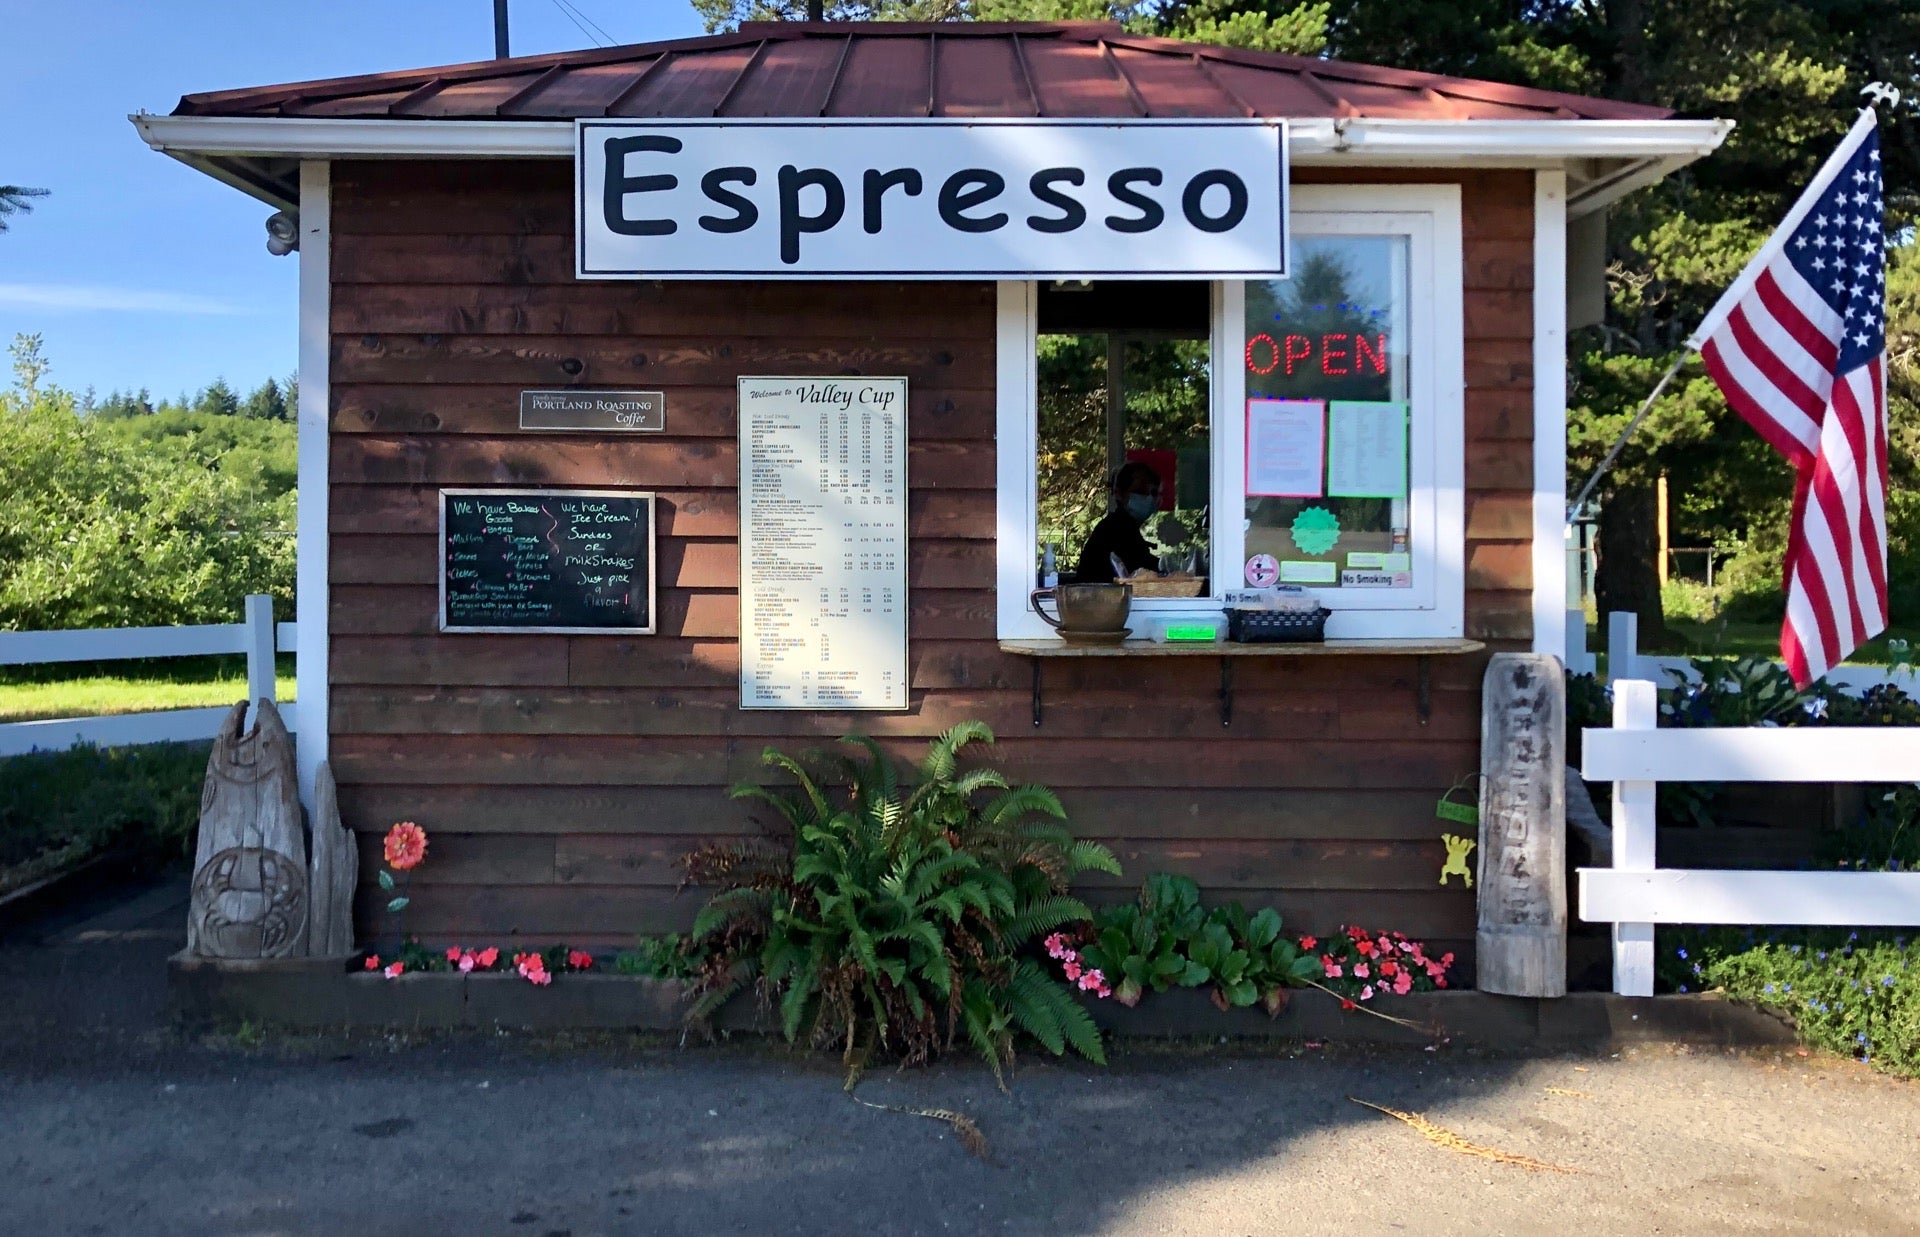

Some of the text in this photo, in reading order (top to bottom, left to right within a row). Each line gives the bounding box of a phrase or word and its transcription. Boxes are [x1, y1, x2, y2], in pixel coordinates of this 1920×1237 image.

[604, 134, 1248, 264] Espresso
[1245, 333, 1386, 375] OPEN
[750, 391, 782, 399] Welcome
[796, 384, 852, 411] Valley
[858, 386, 895, 411] Cup
[532, 400, 652, 411] PORTLAND ROASTING
[615, 412, 646, 427] Coffee
[454, 501, 473, 515] We
[477, 501, 506, 514] have
[561, 501, 609, 512] We have
[571, 514, 591, 523] Ice
[595, 513, 631, 523] Cream
[577, 571, 630, 587] Just pick
[1342, 574, 1393, 585] No Smoking
